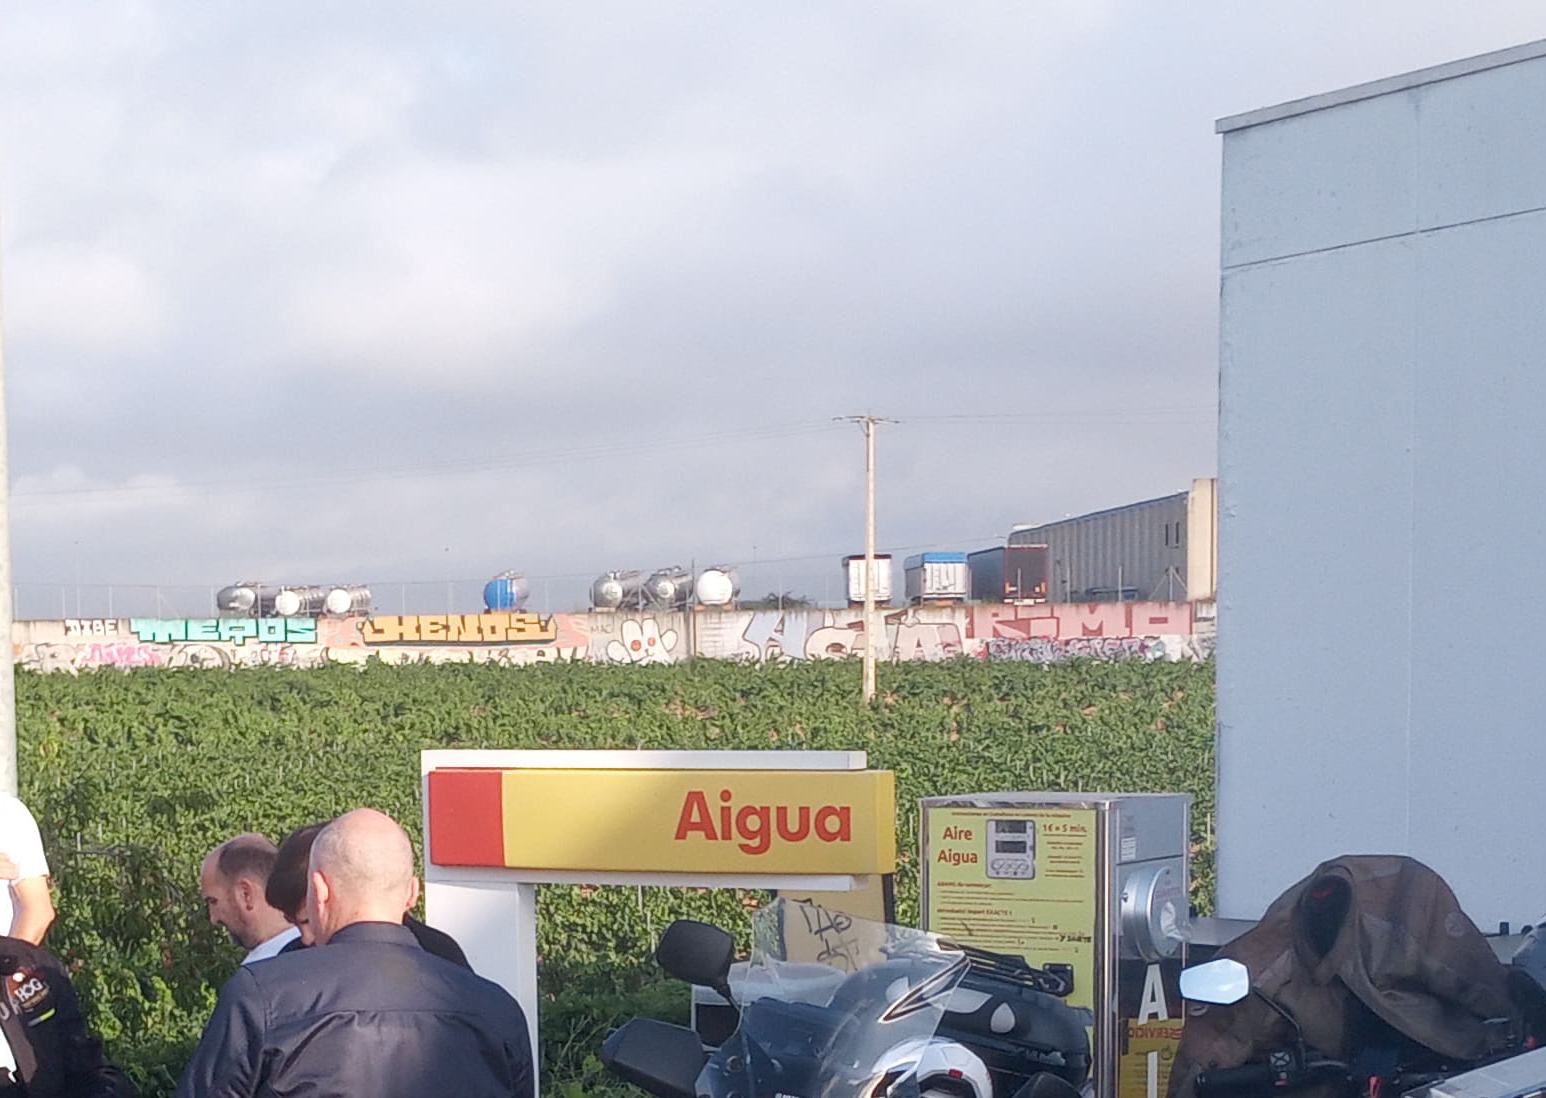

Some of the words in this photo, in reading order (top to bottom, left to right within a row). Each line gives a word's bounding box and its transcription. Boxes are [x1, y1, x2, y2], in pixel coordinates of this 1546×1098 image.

[674, 789, 852, 855] Aigua
[942, 825, 973, 841] Aire
[937, 849, 979, 866] Aigua
